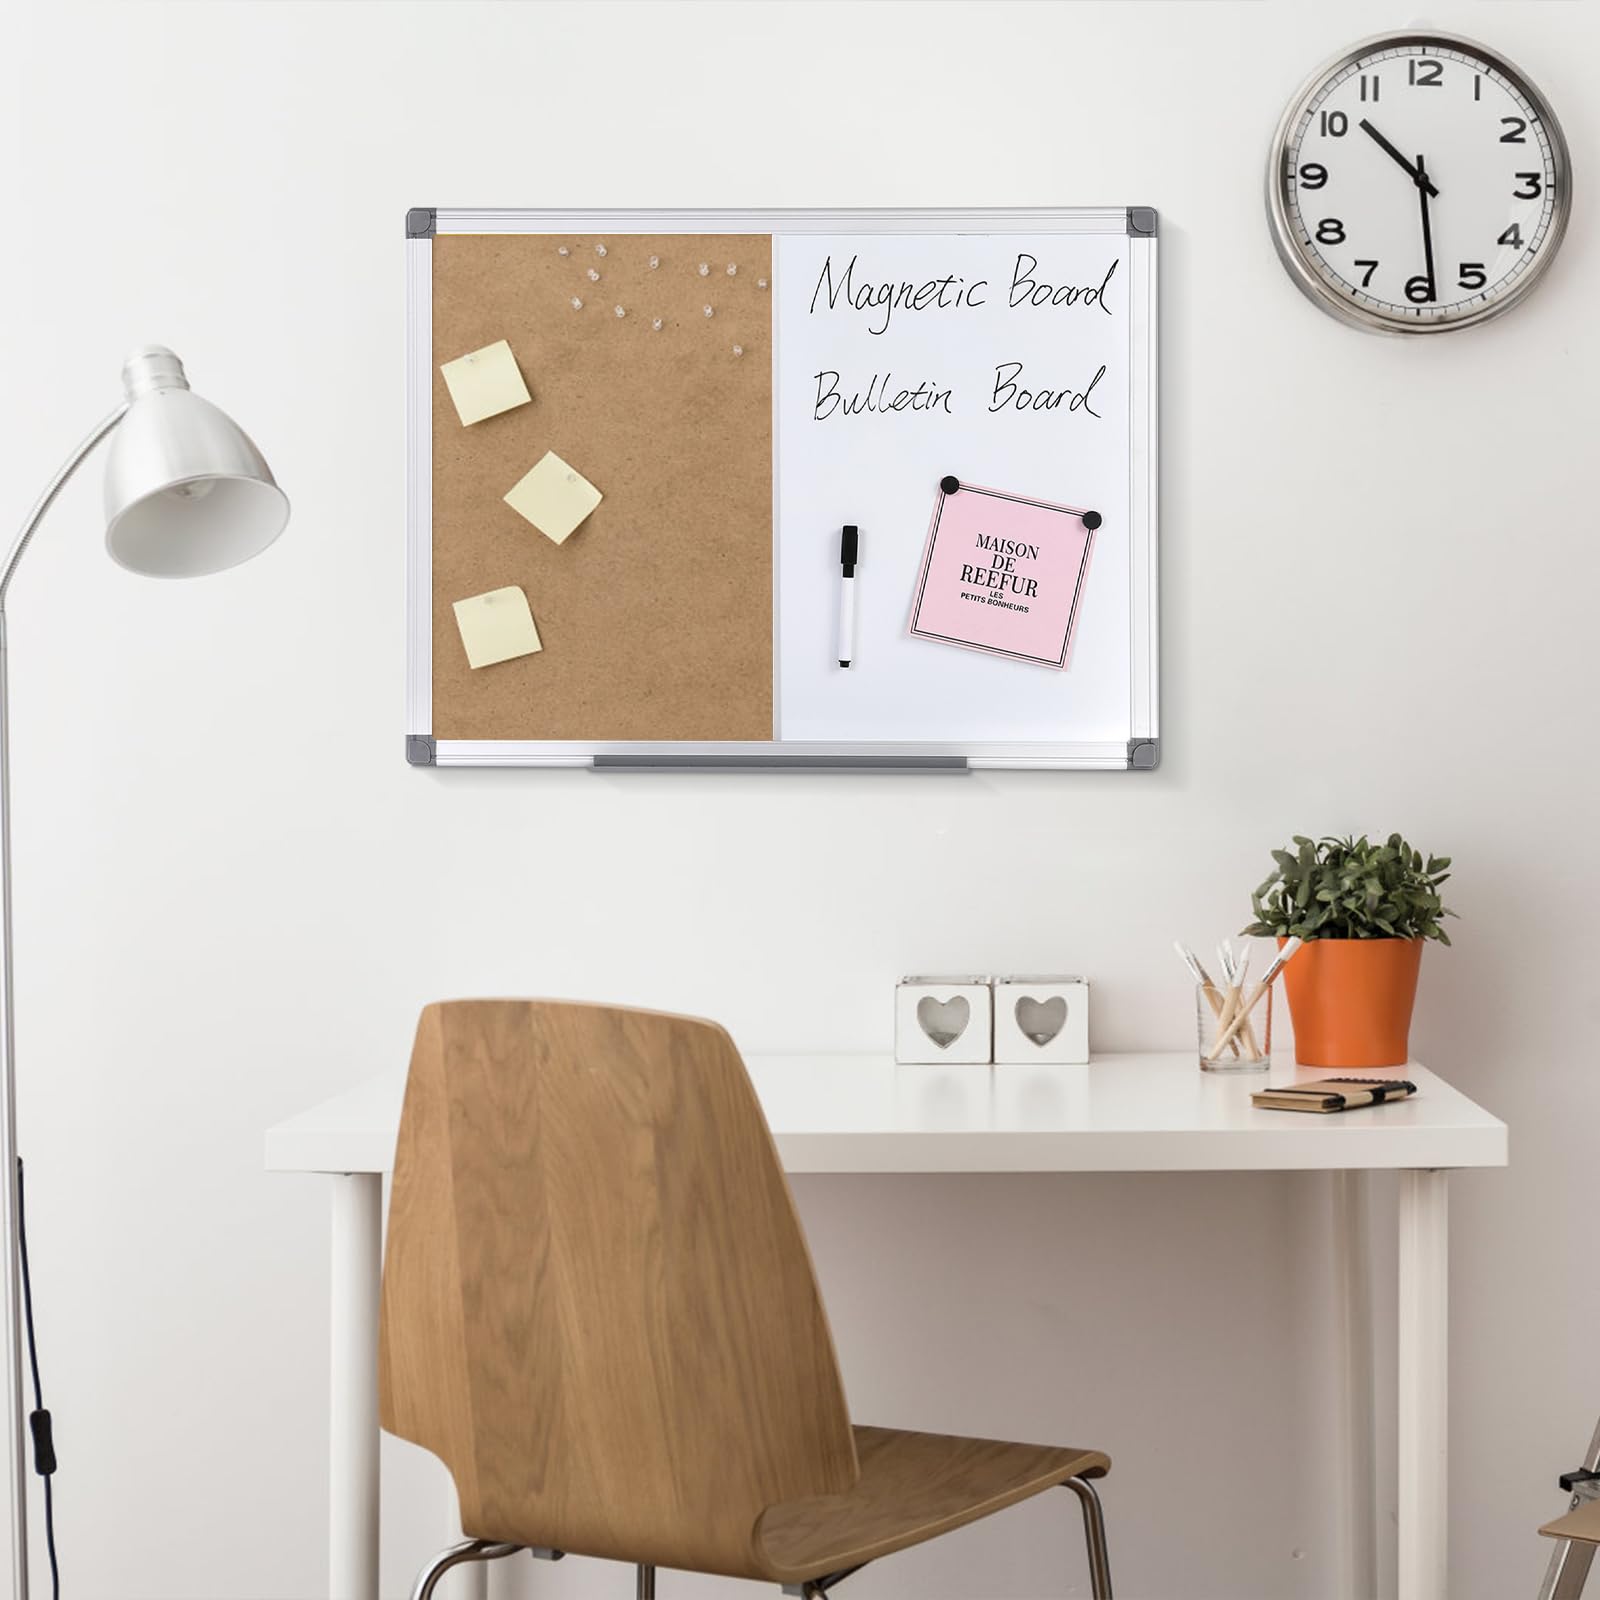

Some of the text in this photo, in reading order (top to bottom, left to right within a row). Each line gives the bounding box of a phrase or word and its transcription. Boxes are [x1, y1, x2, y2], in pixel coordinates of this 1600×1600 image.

[1409, 59, 1444, 86] 12
[1360, 75, 1379, 102] 11
[1474, 74, 1480, 101] 1
[1320, 110, 1348, 137] 10
[1499, 117, 1526, 143] 2
[1299, 163, 1328, 189] 9
[1512, 172, 1541, 200] 3
[1315, 218, 1346, 245] 8
[1497, 223, 1524, 250] 4
[1354, 260, 1379, 287] 7
[1458, 263, 1487, 290] 5
[810, 254, 1119, 335] Magnetic Board
[1404, 276, 1432, 303] 6
[813, 362, 1106, 420] Bulletin Board
[976, 533, 1040, 560] MAISON
[991, 553, 1016, 573] DE
[960, 563, 1038, 598] REEFUR
[960, 591, 1030, 613] PETITS BONHEURS
[989, 590, 1004, 599] LES
